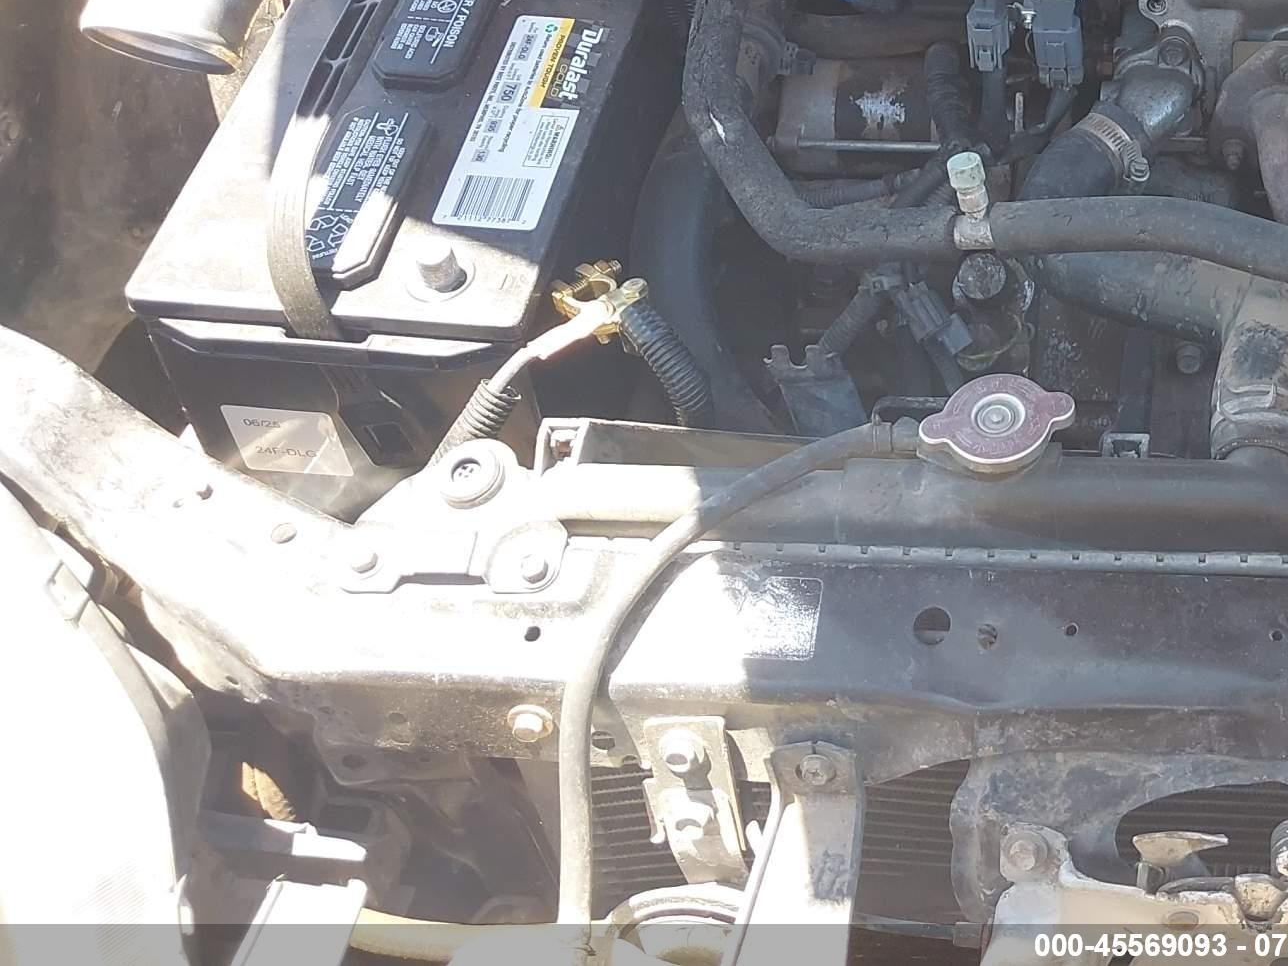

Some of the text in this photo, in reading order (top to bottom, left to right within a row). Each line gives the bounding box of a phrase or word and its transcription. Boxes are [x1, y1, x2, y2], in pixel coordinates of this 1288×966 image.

[443, 14, 468, 47] POISON
[540, 34, 565, 88] PROVEN TOUGH
[558, 28, 603, 100] Duralast
[499, 83, 517, 101] 750
[550, 64, 568, 96] GOLD
